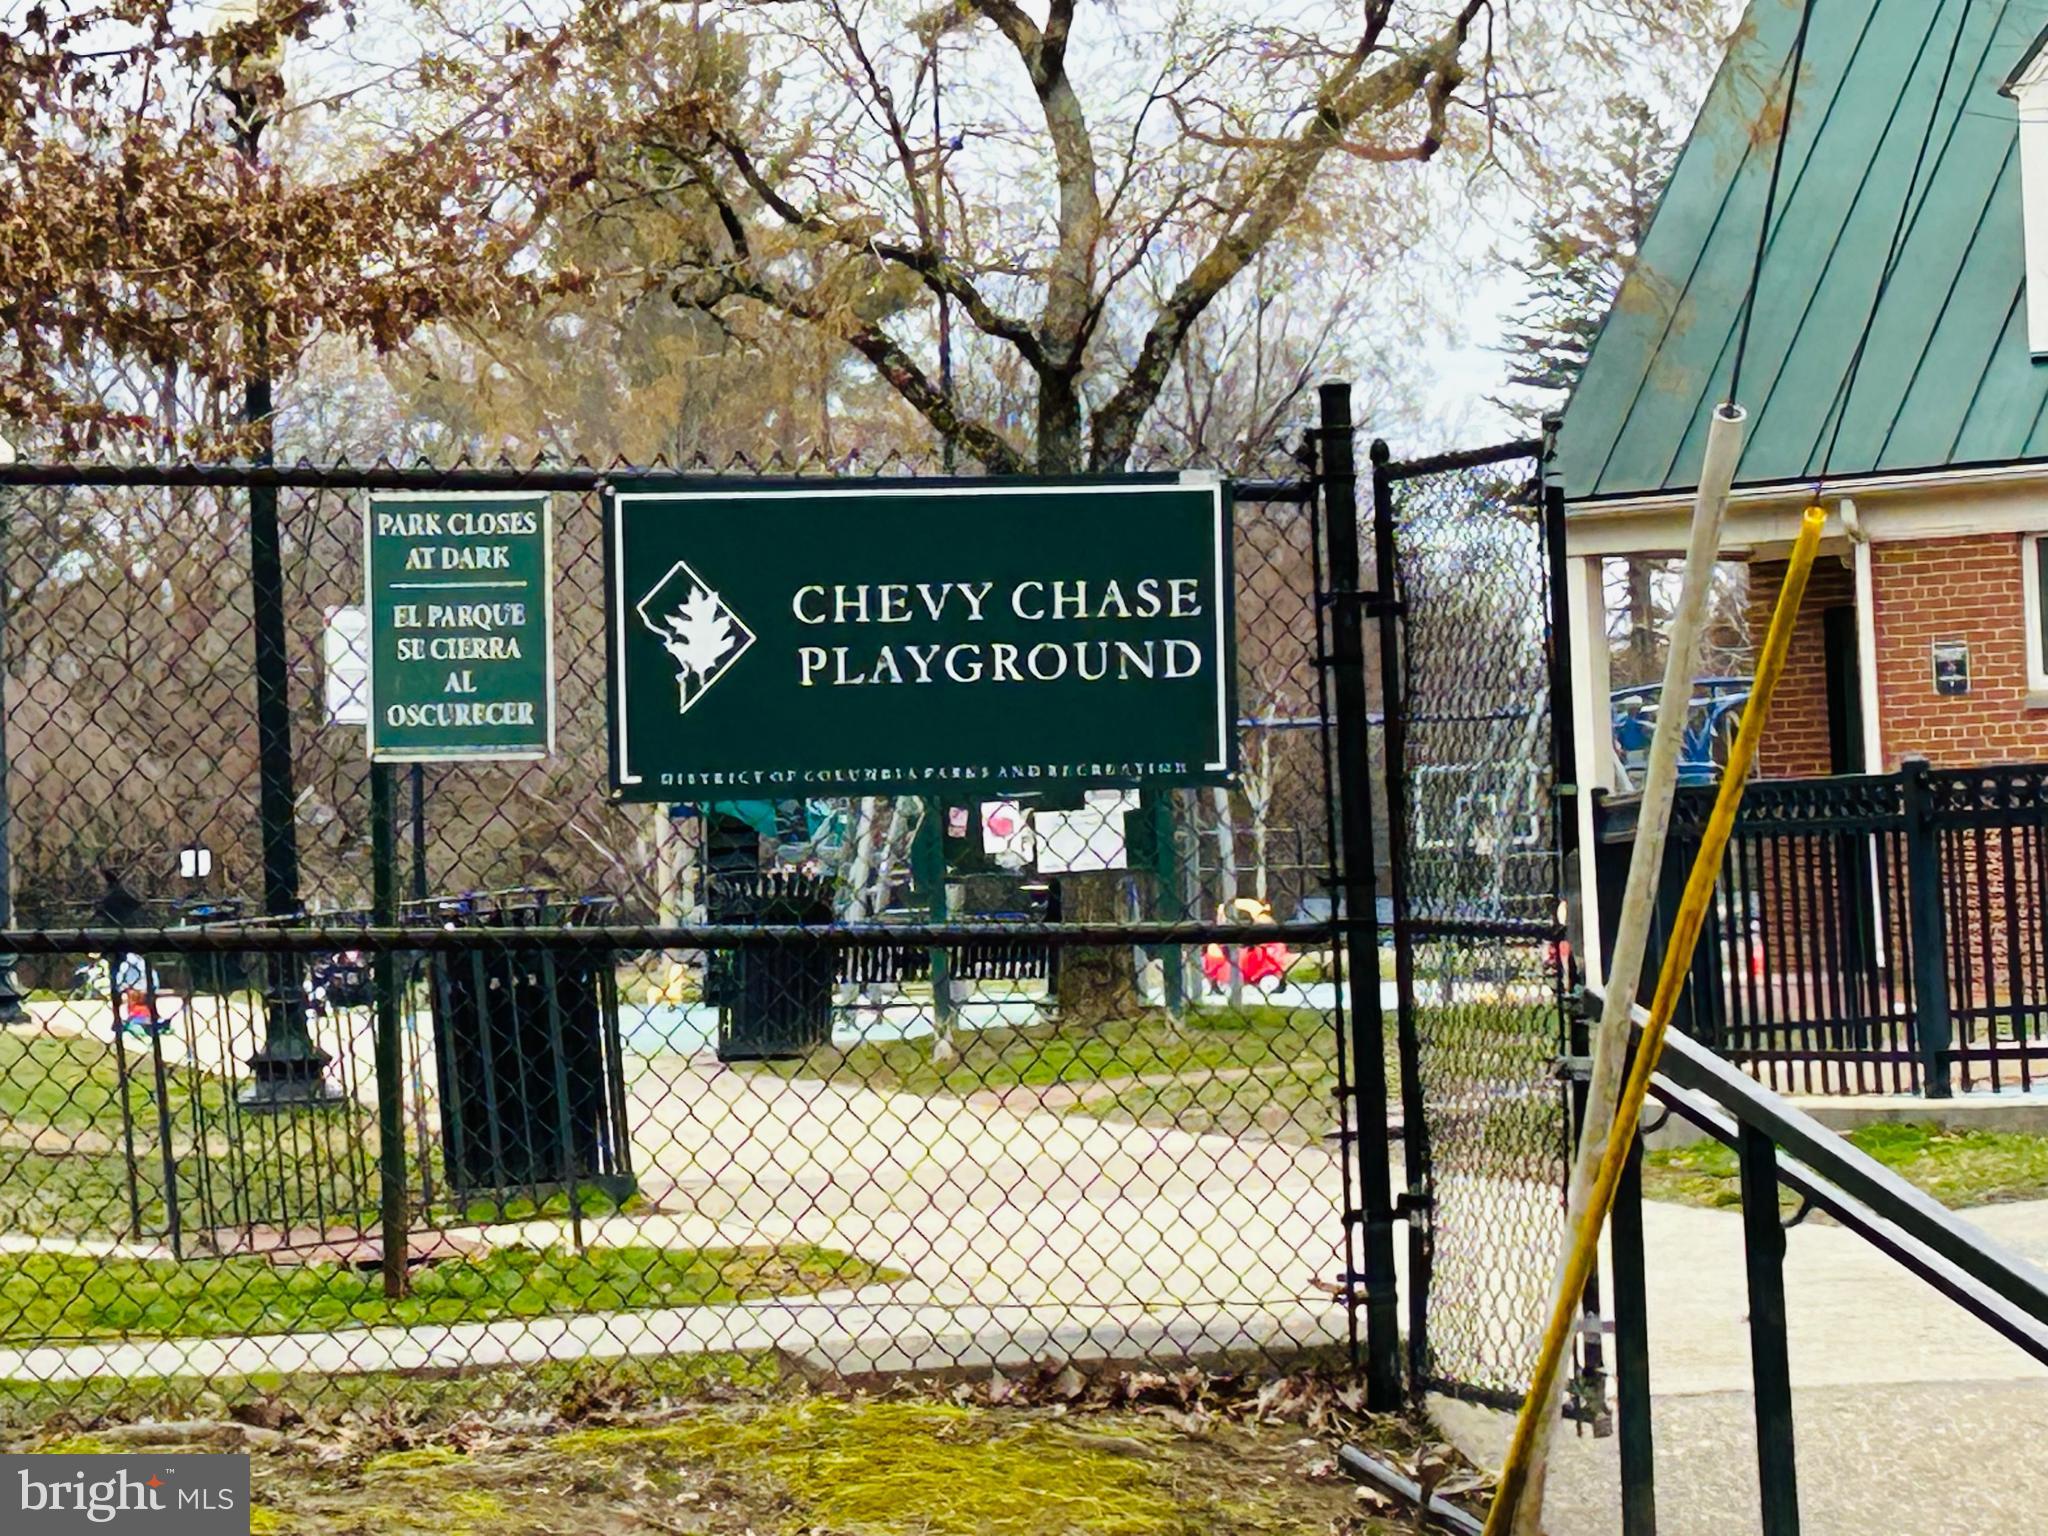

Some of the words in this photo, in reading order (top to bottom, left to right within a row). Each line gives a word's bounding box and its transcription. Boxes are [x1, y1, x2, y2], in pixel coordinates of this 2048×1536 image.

[378, 512, 442, 536] PARK
[447, 511, 537, 536] CLOSES
[405, 547, 435, 570] AT
[441, 546, 510, 570] DARK
[792, 581, 995, 625] CHEVY
[1011, 578, 1203, 621] CHASE
[393, 604, 421, 628] EL
[428, 603, 526, 631] PARQUE
[397, 638, 425, 661] SE
[430, 637, 522, 660] CIERRA
[798, 639, 1203, 686] PLAYGROUND
[444, 670, 477, 693] AL
[387, 702, 535, 727] OSCURECER
[997, 764, 1042, 778] AND
